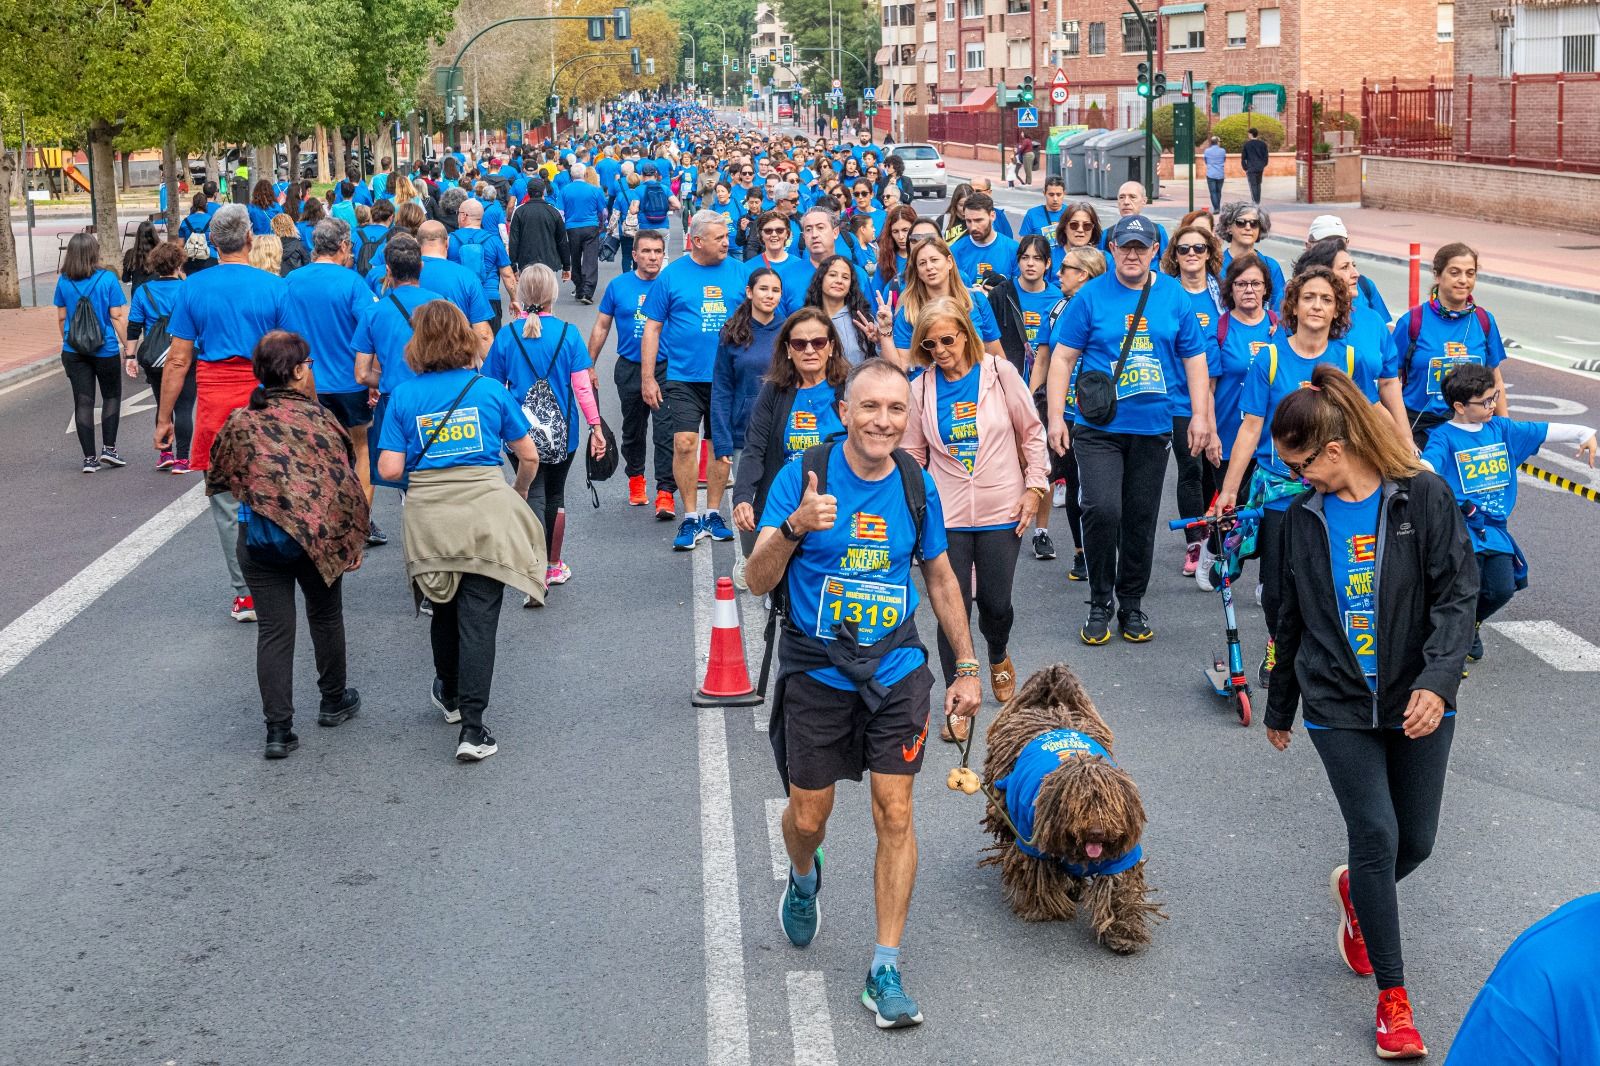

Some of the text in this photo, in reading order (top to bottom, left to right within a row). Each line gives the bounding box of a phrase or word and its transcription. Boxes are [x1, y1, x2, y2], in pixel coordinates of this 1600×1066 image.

[1120, 368, 1160, 387] 2053
[425, 423, 476, 443] 2880
[1464, 457, 1508, 479] 2486
[839, 557, 847, 568] X
[847, 546, 890, 561] MUÉVETE
[829, 600, 898, 628] 1319
